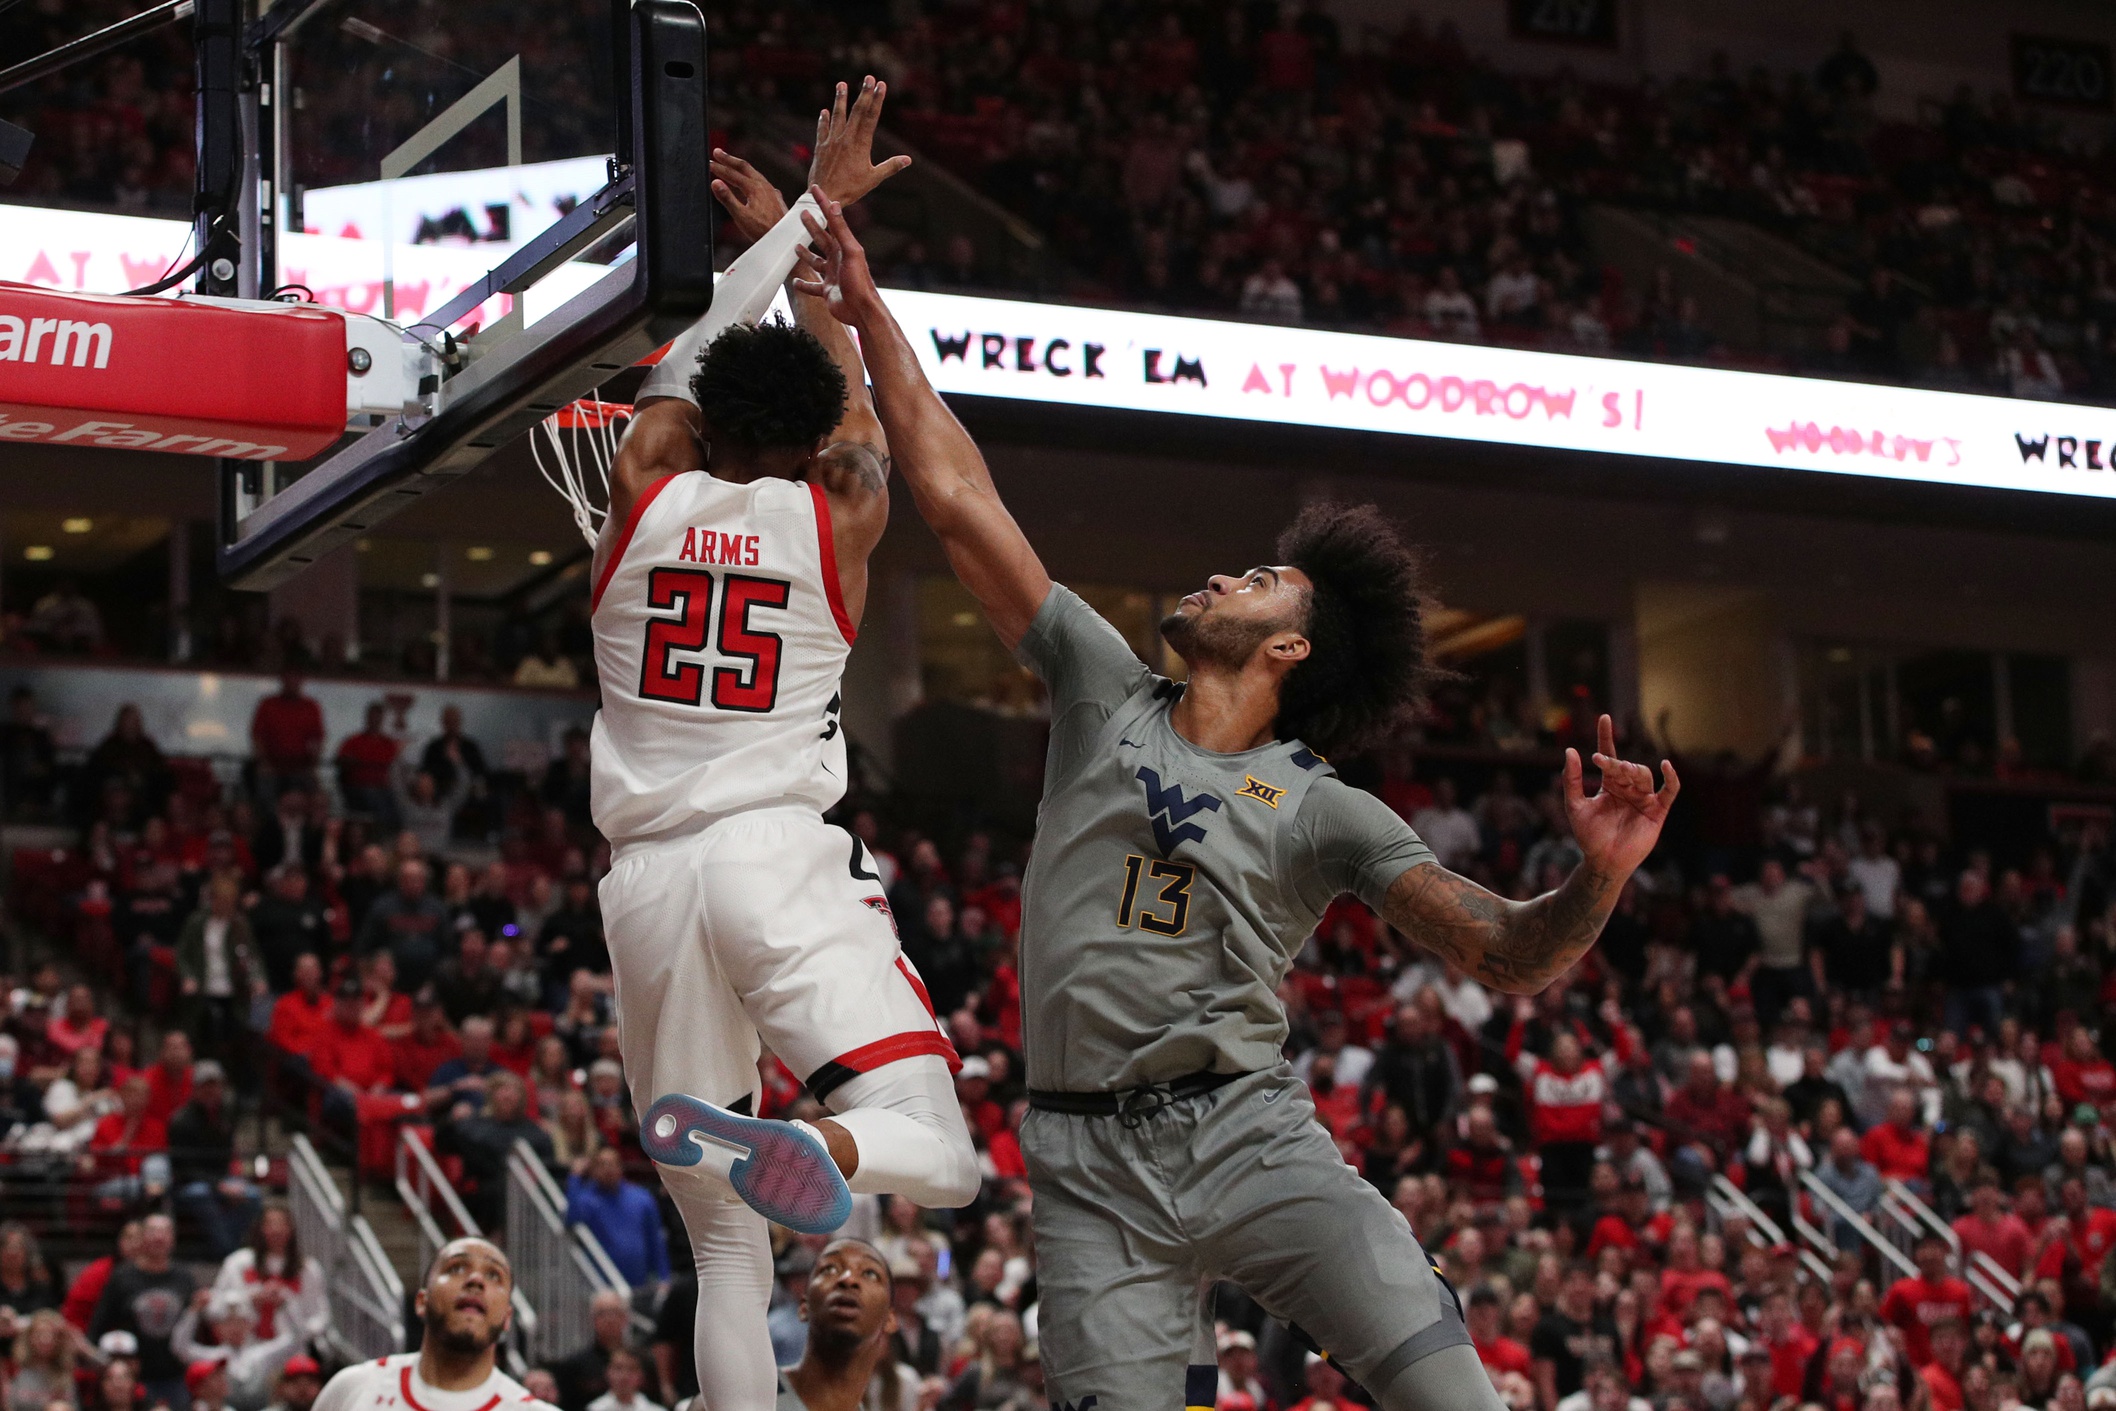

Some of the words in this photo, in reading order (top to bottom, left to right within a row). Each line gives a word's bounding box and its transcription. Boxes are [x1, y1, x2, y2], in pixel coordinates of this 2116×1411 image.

[23, 248, 92, 289] AT
[929, 326, 1107, 379] WRECK
[1241, 361, 1297, 398] AT
[47, 420, 289, 460] Farm
[679, 526, 760, 566] ARMS
[638, 566, 792, 713] 25
[1116, 853, 1197, 938] 13
